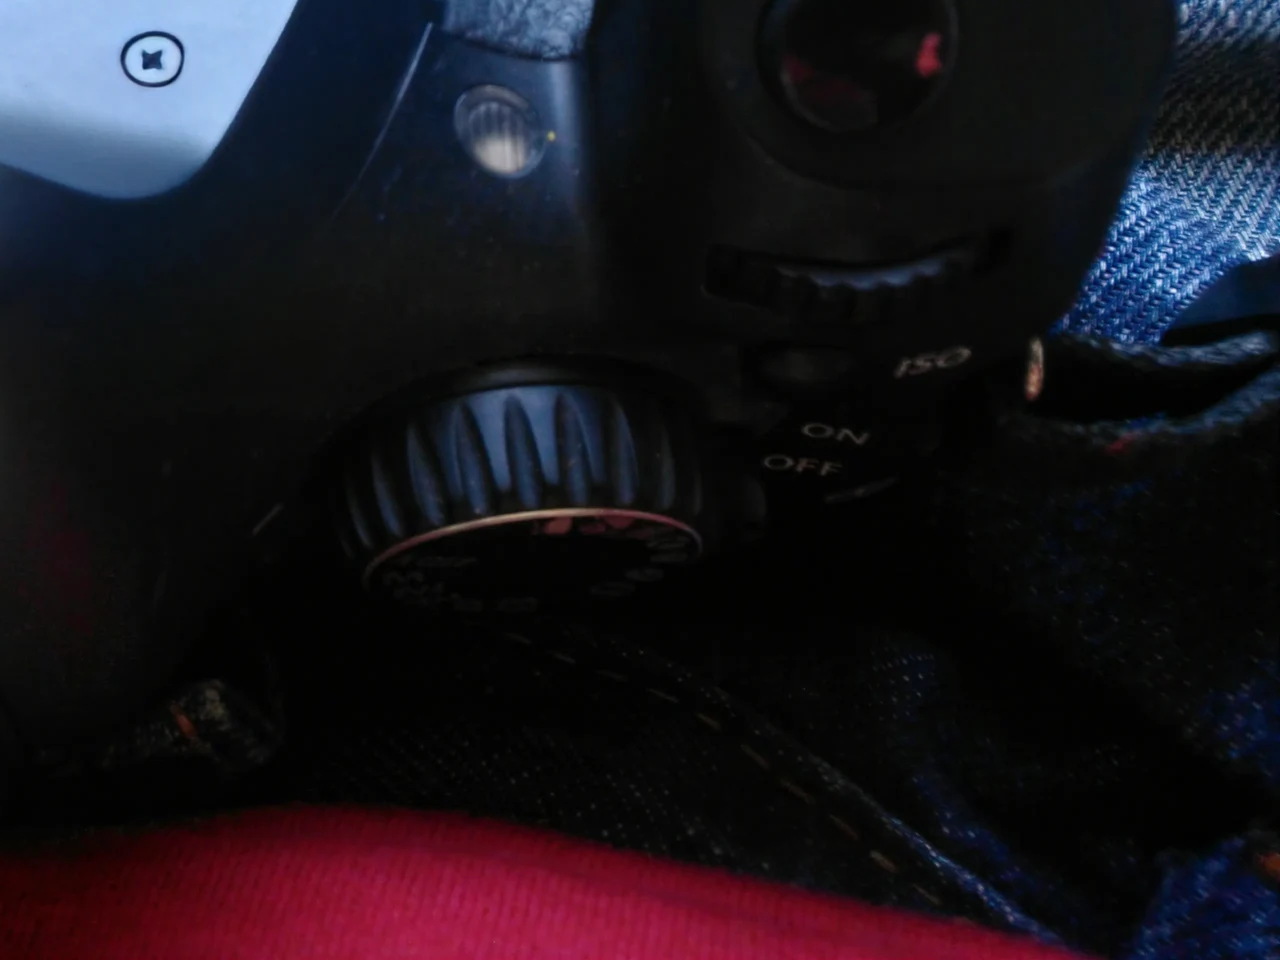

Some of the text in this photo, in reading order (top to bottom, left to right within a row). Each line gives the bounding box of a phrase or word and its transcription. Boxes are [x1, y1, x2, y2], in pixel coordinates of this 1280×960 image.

[893, 344, 973, 378] ISO
[801, 422, 870, 445] ON
[762, 454, 843, 477] OFF
